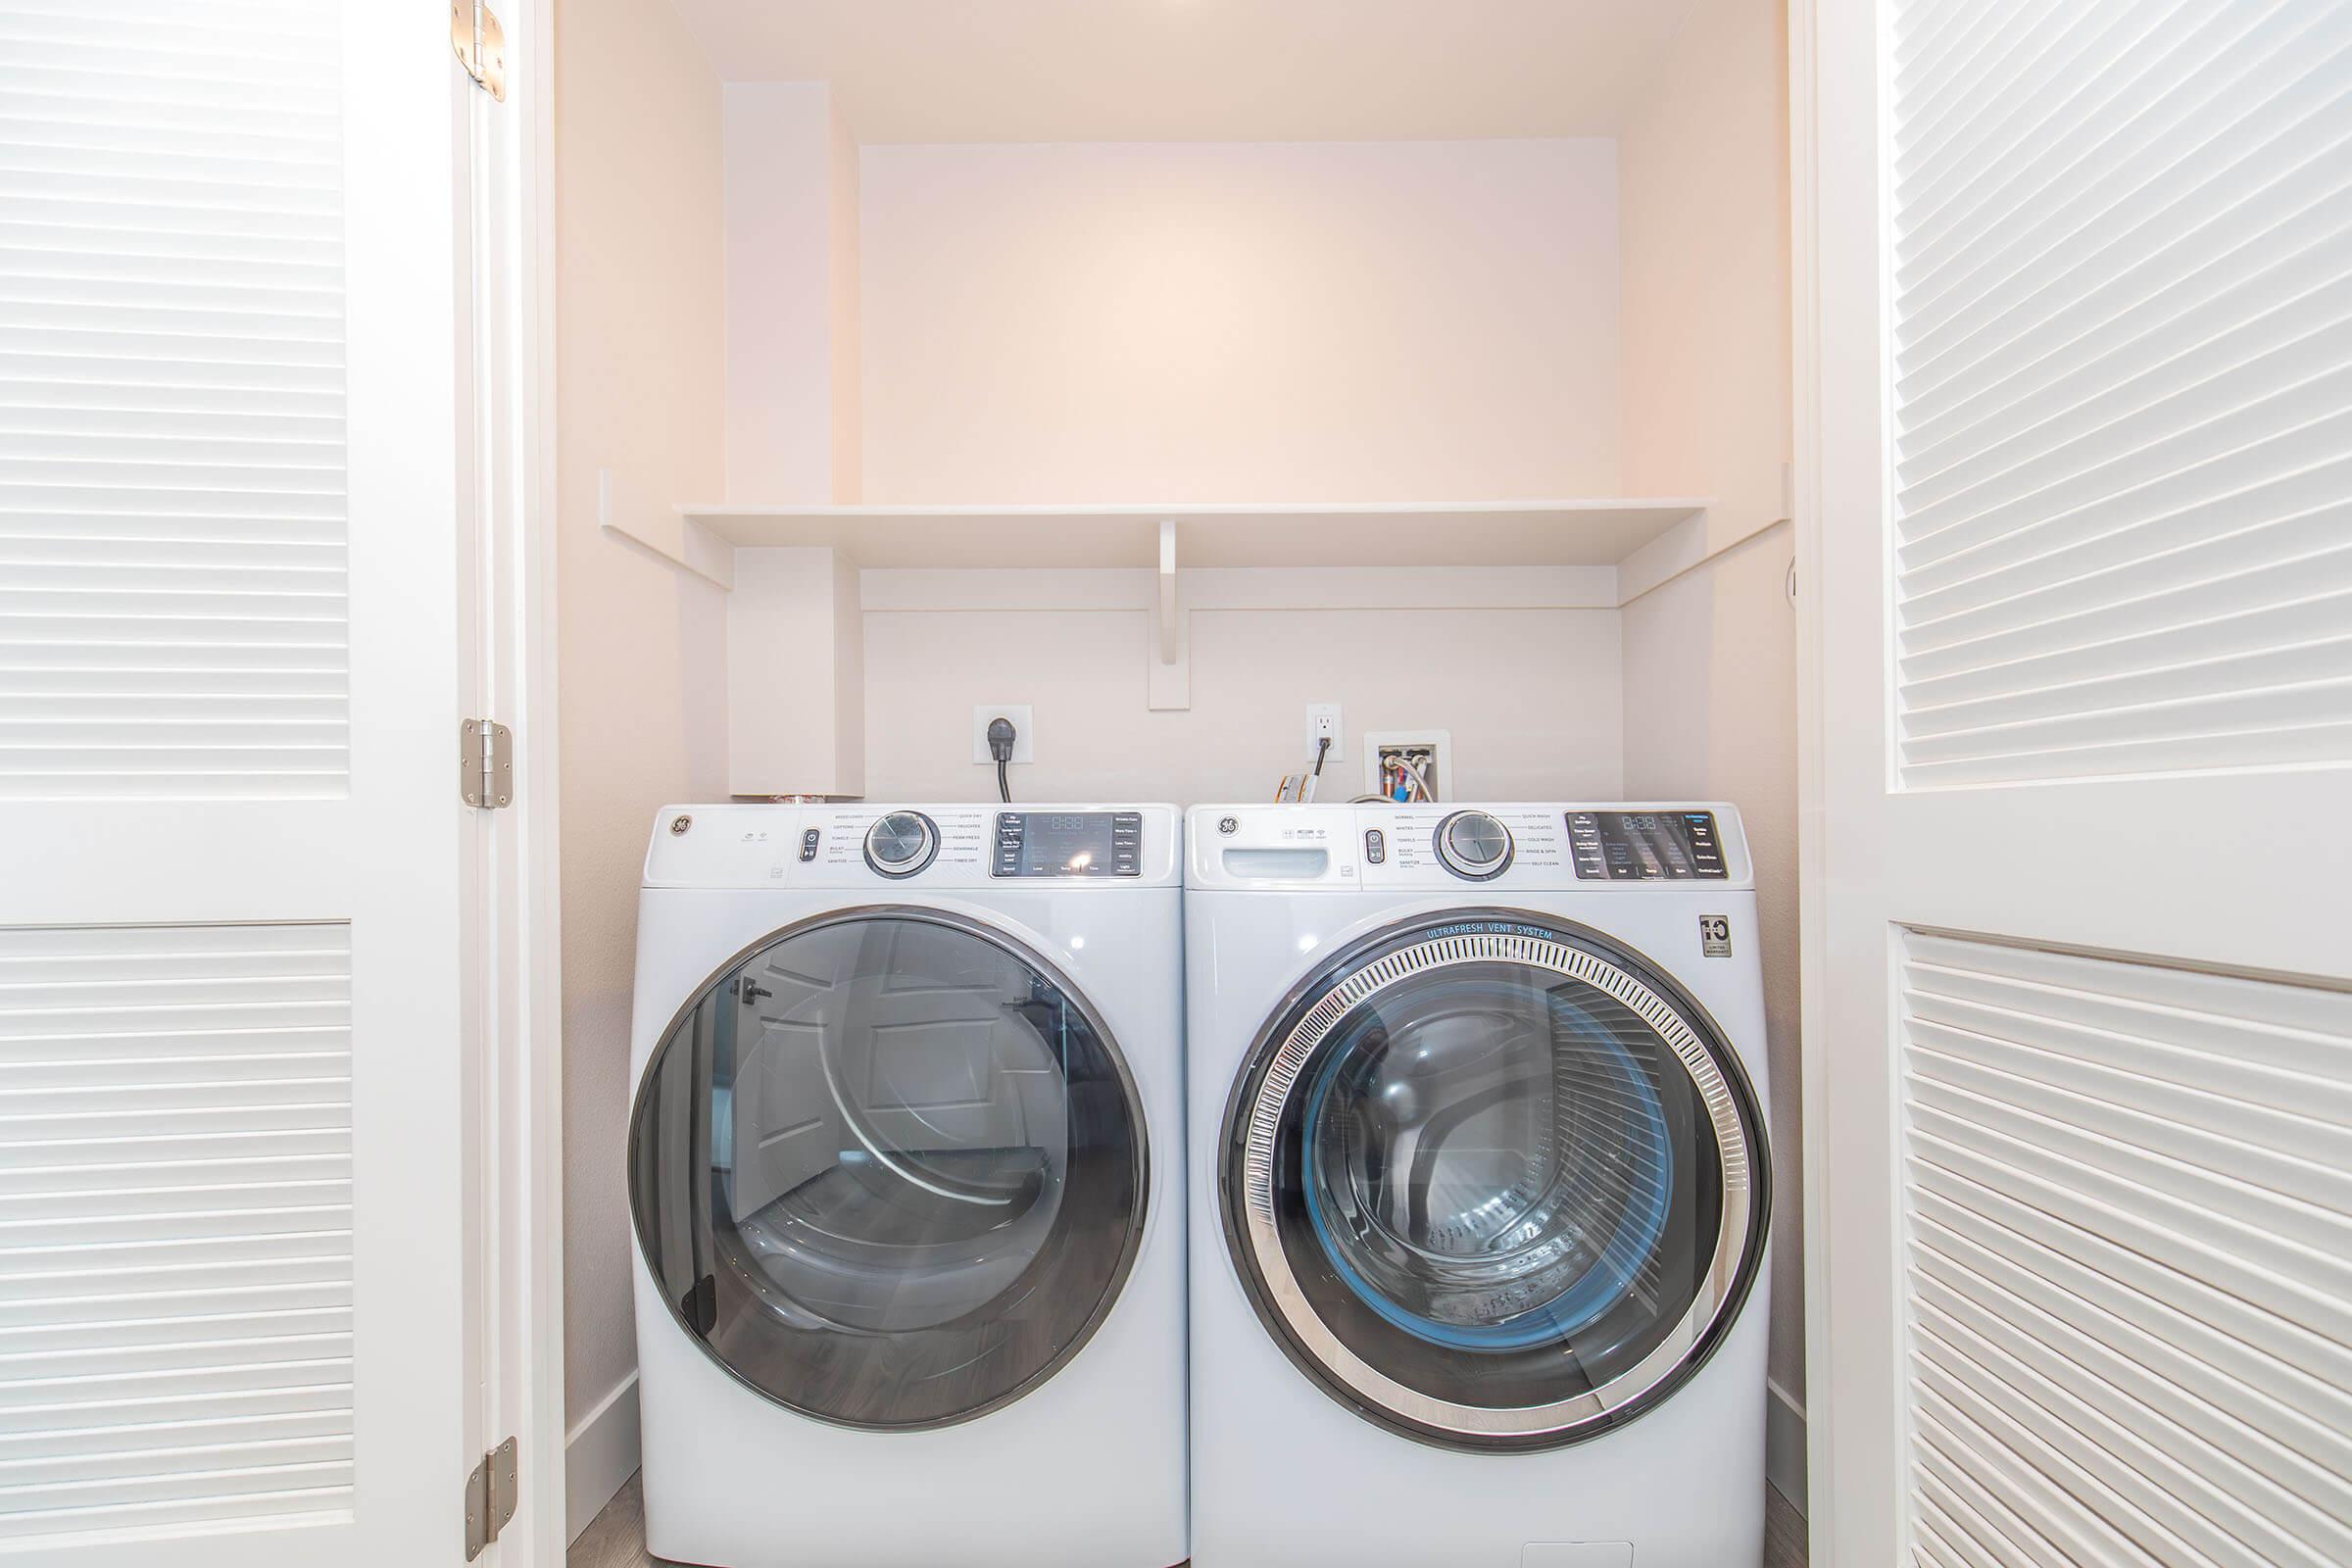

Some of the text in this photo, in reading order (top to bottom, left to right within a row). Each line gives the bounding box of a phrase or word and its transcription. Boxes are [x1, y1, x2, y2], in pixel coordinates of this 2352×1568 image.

[1426, 923, 1553, 940] ULTRAFRESH VENT SYSTEM
[1701, 920, 1729, 941] 10
